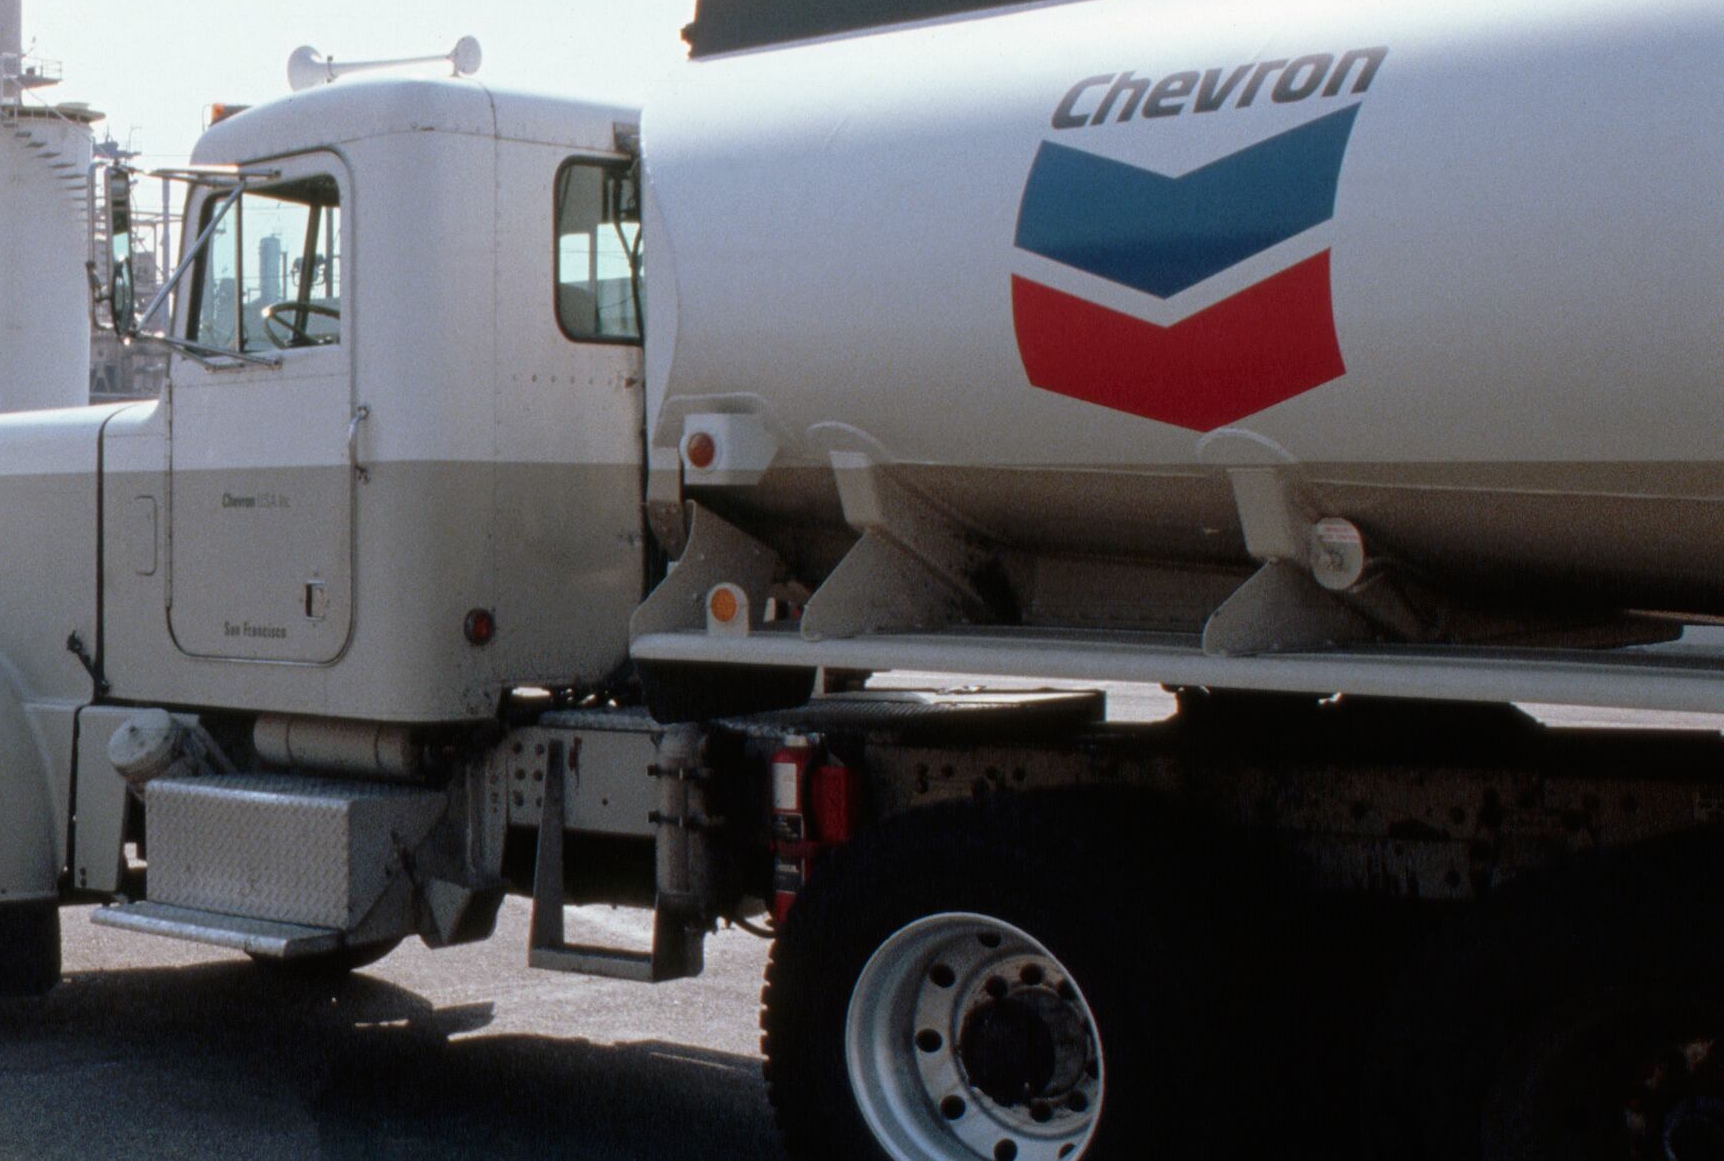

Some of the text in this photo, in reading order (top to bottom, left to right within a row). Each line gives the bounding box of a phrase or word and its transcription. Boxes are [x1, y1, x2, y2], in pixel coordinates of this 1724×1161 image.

[1051, 45, 1389, 130] Chevron
[222, 493, 256, 508] Chevron
[224, 621, 287, 638] San Francisco
